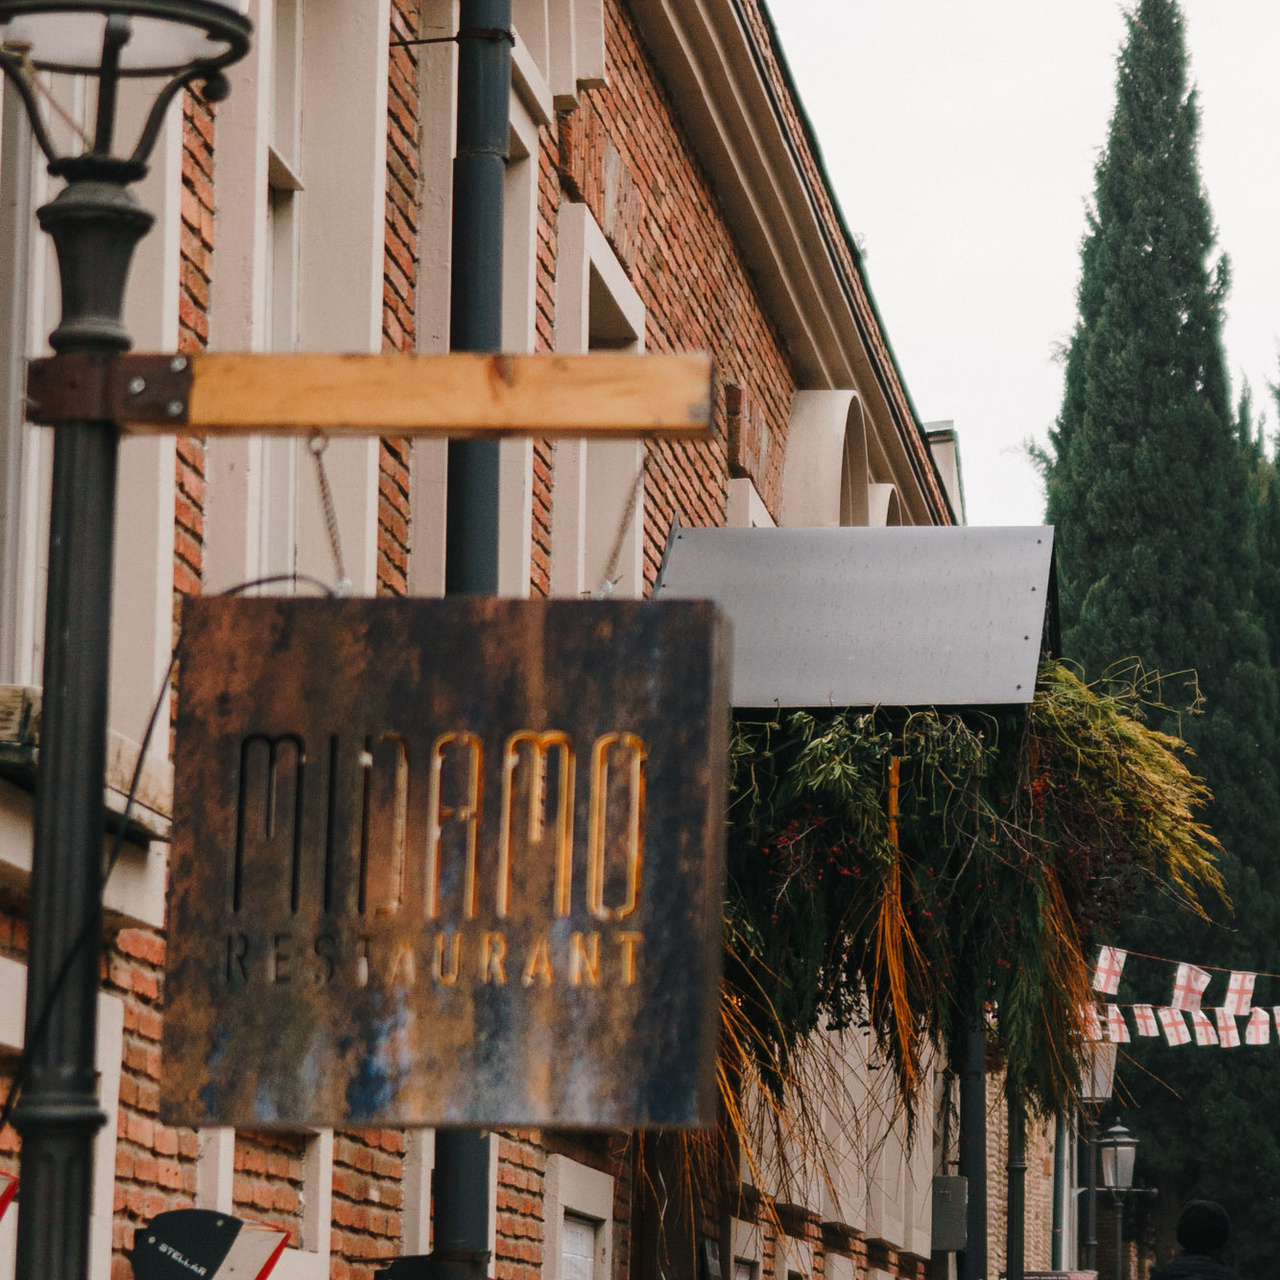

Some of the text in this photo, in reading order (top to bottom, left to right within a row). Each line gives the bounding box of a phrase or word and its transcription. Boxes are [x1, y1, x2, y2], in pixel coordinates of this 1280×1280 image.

[231, 729, 648, 919] MIDAMO
[222, 931, 645, 988] RESTAURANT
[158, 1242, 207, 1277] STELLAR
